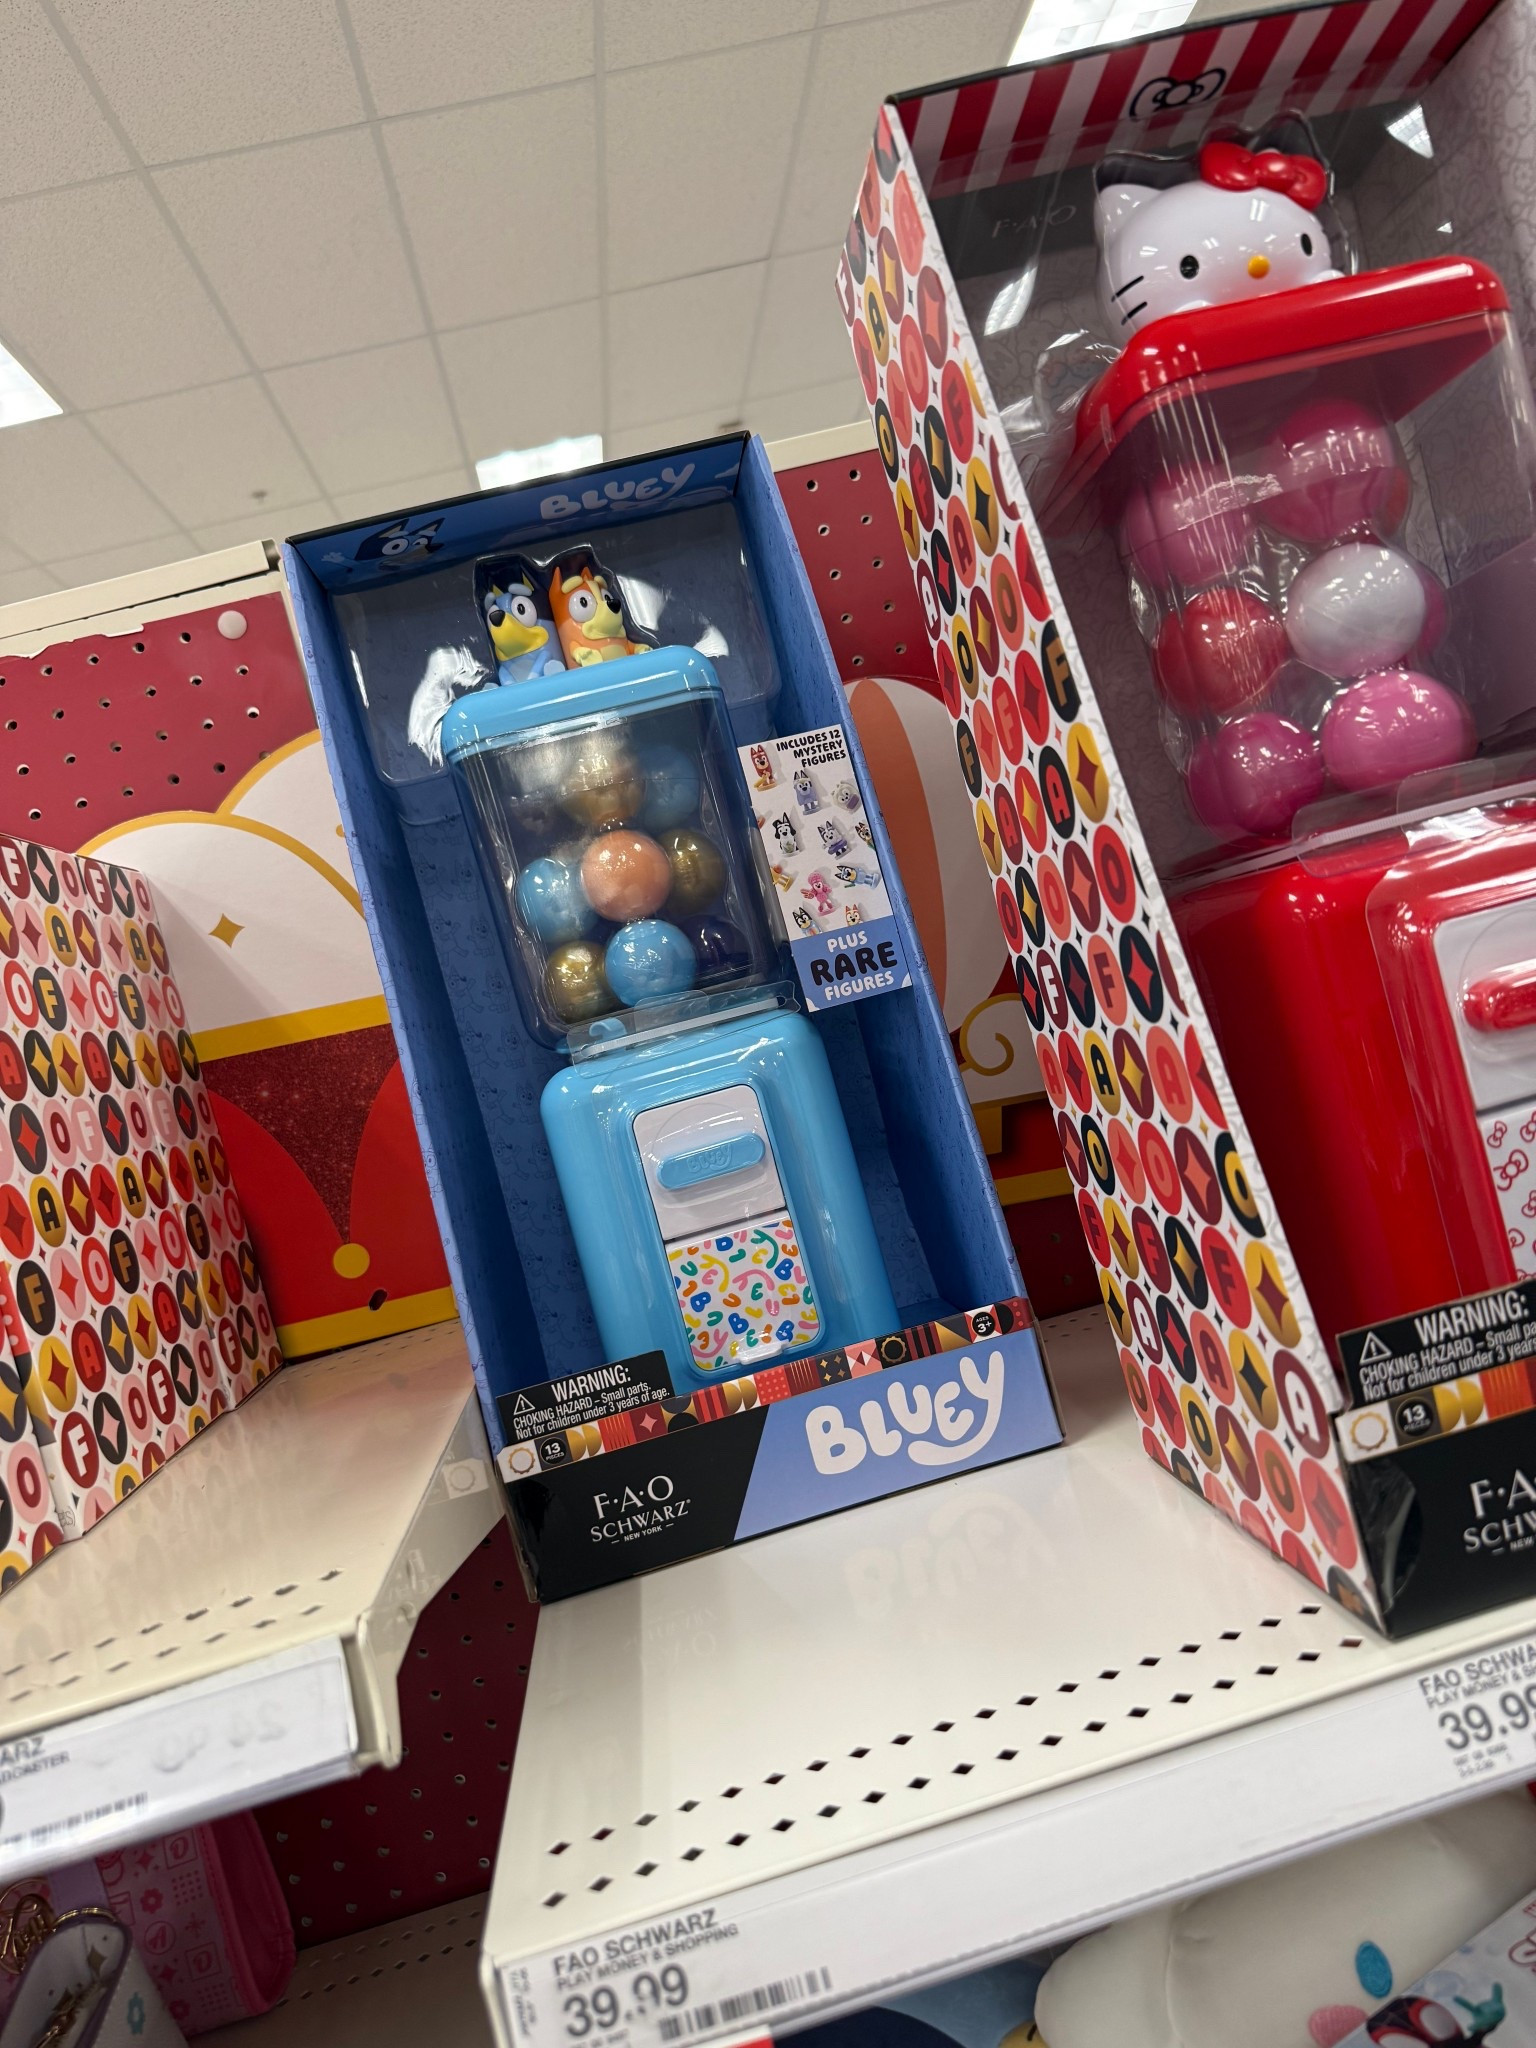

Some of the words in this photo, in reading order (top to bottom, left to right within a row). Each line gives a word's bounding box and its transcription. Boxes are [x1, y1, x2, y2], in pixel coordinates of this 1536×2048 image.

[776, 732, 827, 751] INCLUDES
[829, 729, 841, 740] 12
[793, 739, 843, 758] MYSTERY
[801, 750, 846, 767] FIGURES
[826, 930, 868, 953] PLUS
[811, 941, 898, 986] RARE
[824, 971, 894, 1000] FIGURES
[1414, 1290, 1530, 1347] WARNING:
[1359, 1352, 1419, 1386] CHOKING
[1420, 1336, 1473, 1367] HAZARD
[1485, 1324, 1521, 1348] Small
[1362, 1382, 1386, 1403] Not
[1387, 1376, 1405, 1393] for
[1407, 1363, 1457, 1389] children
[1458, 1351, 1494, 1373] under
[1495, 1345, 1506, 1362] 3
[551, 1364, 632, 1403] WARNING:
[513, 1407, 555, 1430] CHOKING
[557, 1396, 593, 1417] HAZARD
[601, 1387, 626, 1403] Small
[627, 1381, 652, 1400] parts.
[515, 1425, 533, 1441] Not
[533, 1421, 546, 1436] for
[546, 1411, 581, 1433] children
[583, 1403, 608, 1421] under
[609, 1400, 616, 1413] 3
[616, 1396, 641, 1413] years
[641, 1391, 651, 1403] of
[651, 1388, 671, 1402] age.
[805, 1350, 1004, 1475] BLUEY
[1402, 1404, 1427, 1423] 13
[545, 1442, 561, 1456] 13
[590, 1500, 689, 1542] SCHWARZ
[624, 1531, 640, 1542] NEW
[642, 1525, 663, 1537] YORK
[1418, 1668, 1462, 1697] FAO
[1462, 1674, 1508, 1698] MONEY
[553, 1946, 601, 1977] FAO
[603, 1907, 720, 1961] SCHWARZ
[556, 1967, 594, 1993] PLAY
[599, 1952, 650, 1978] MONEY
[666, 1923, 740, 1958] SHOPPING
